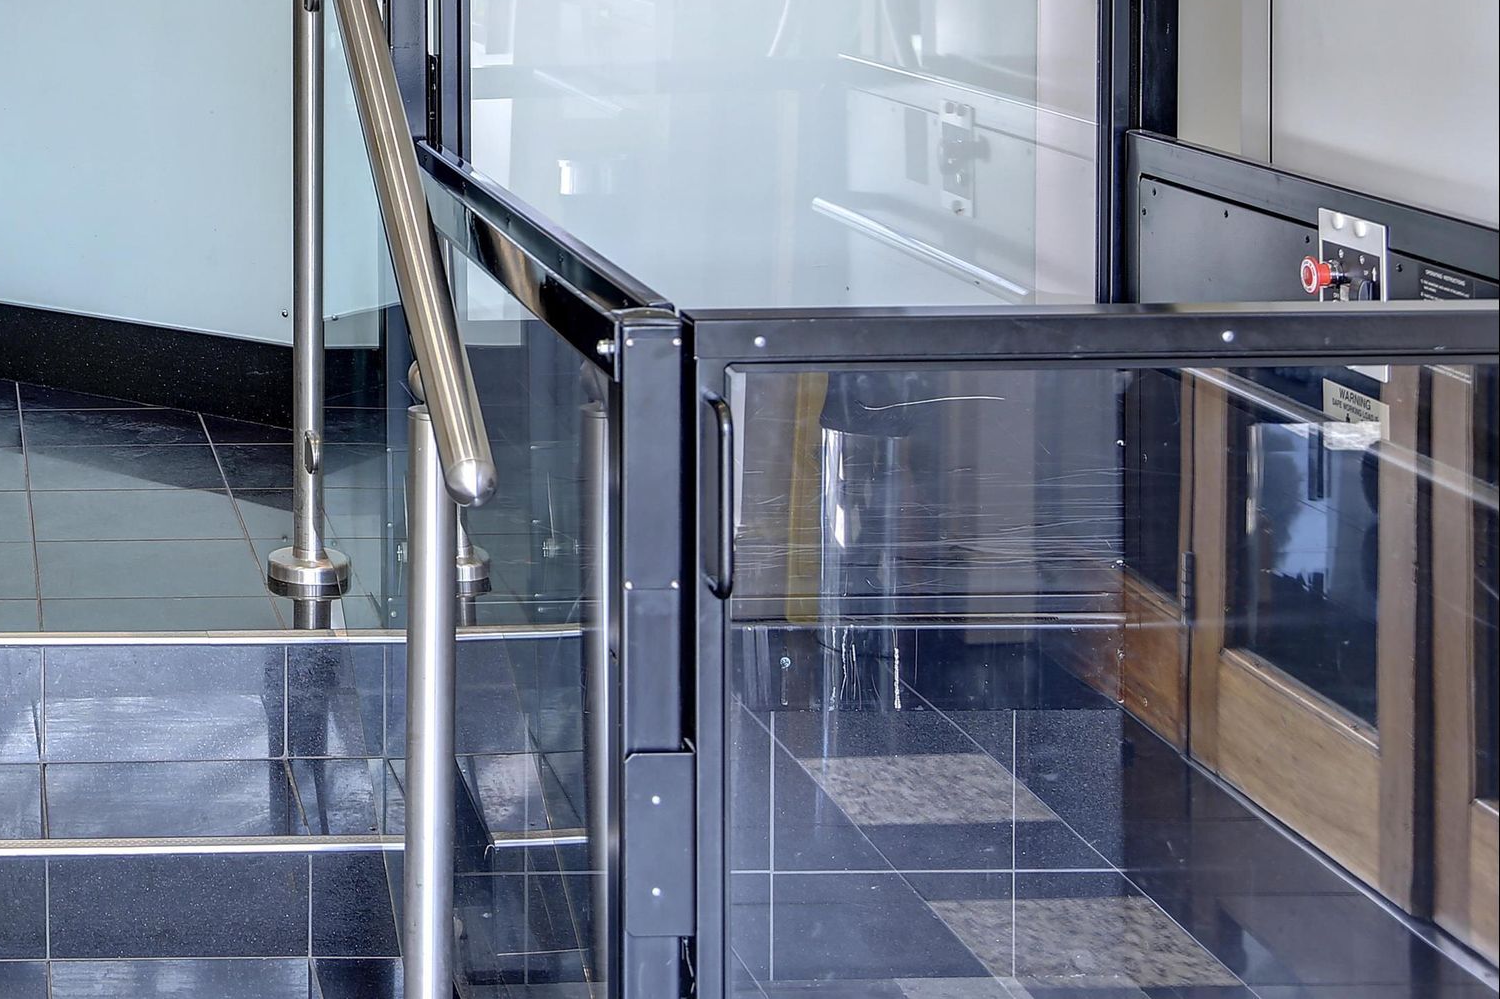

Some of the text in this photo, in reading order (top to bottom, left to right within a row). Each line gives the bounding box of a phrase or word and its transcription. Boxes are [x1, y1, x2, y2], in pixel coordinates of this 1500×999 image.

[1332, 397, 1343, 409] SAFE
[1342, 402, 1362, 417] WORKING
[1339, 387, 1371, 411] WARNING
